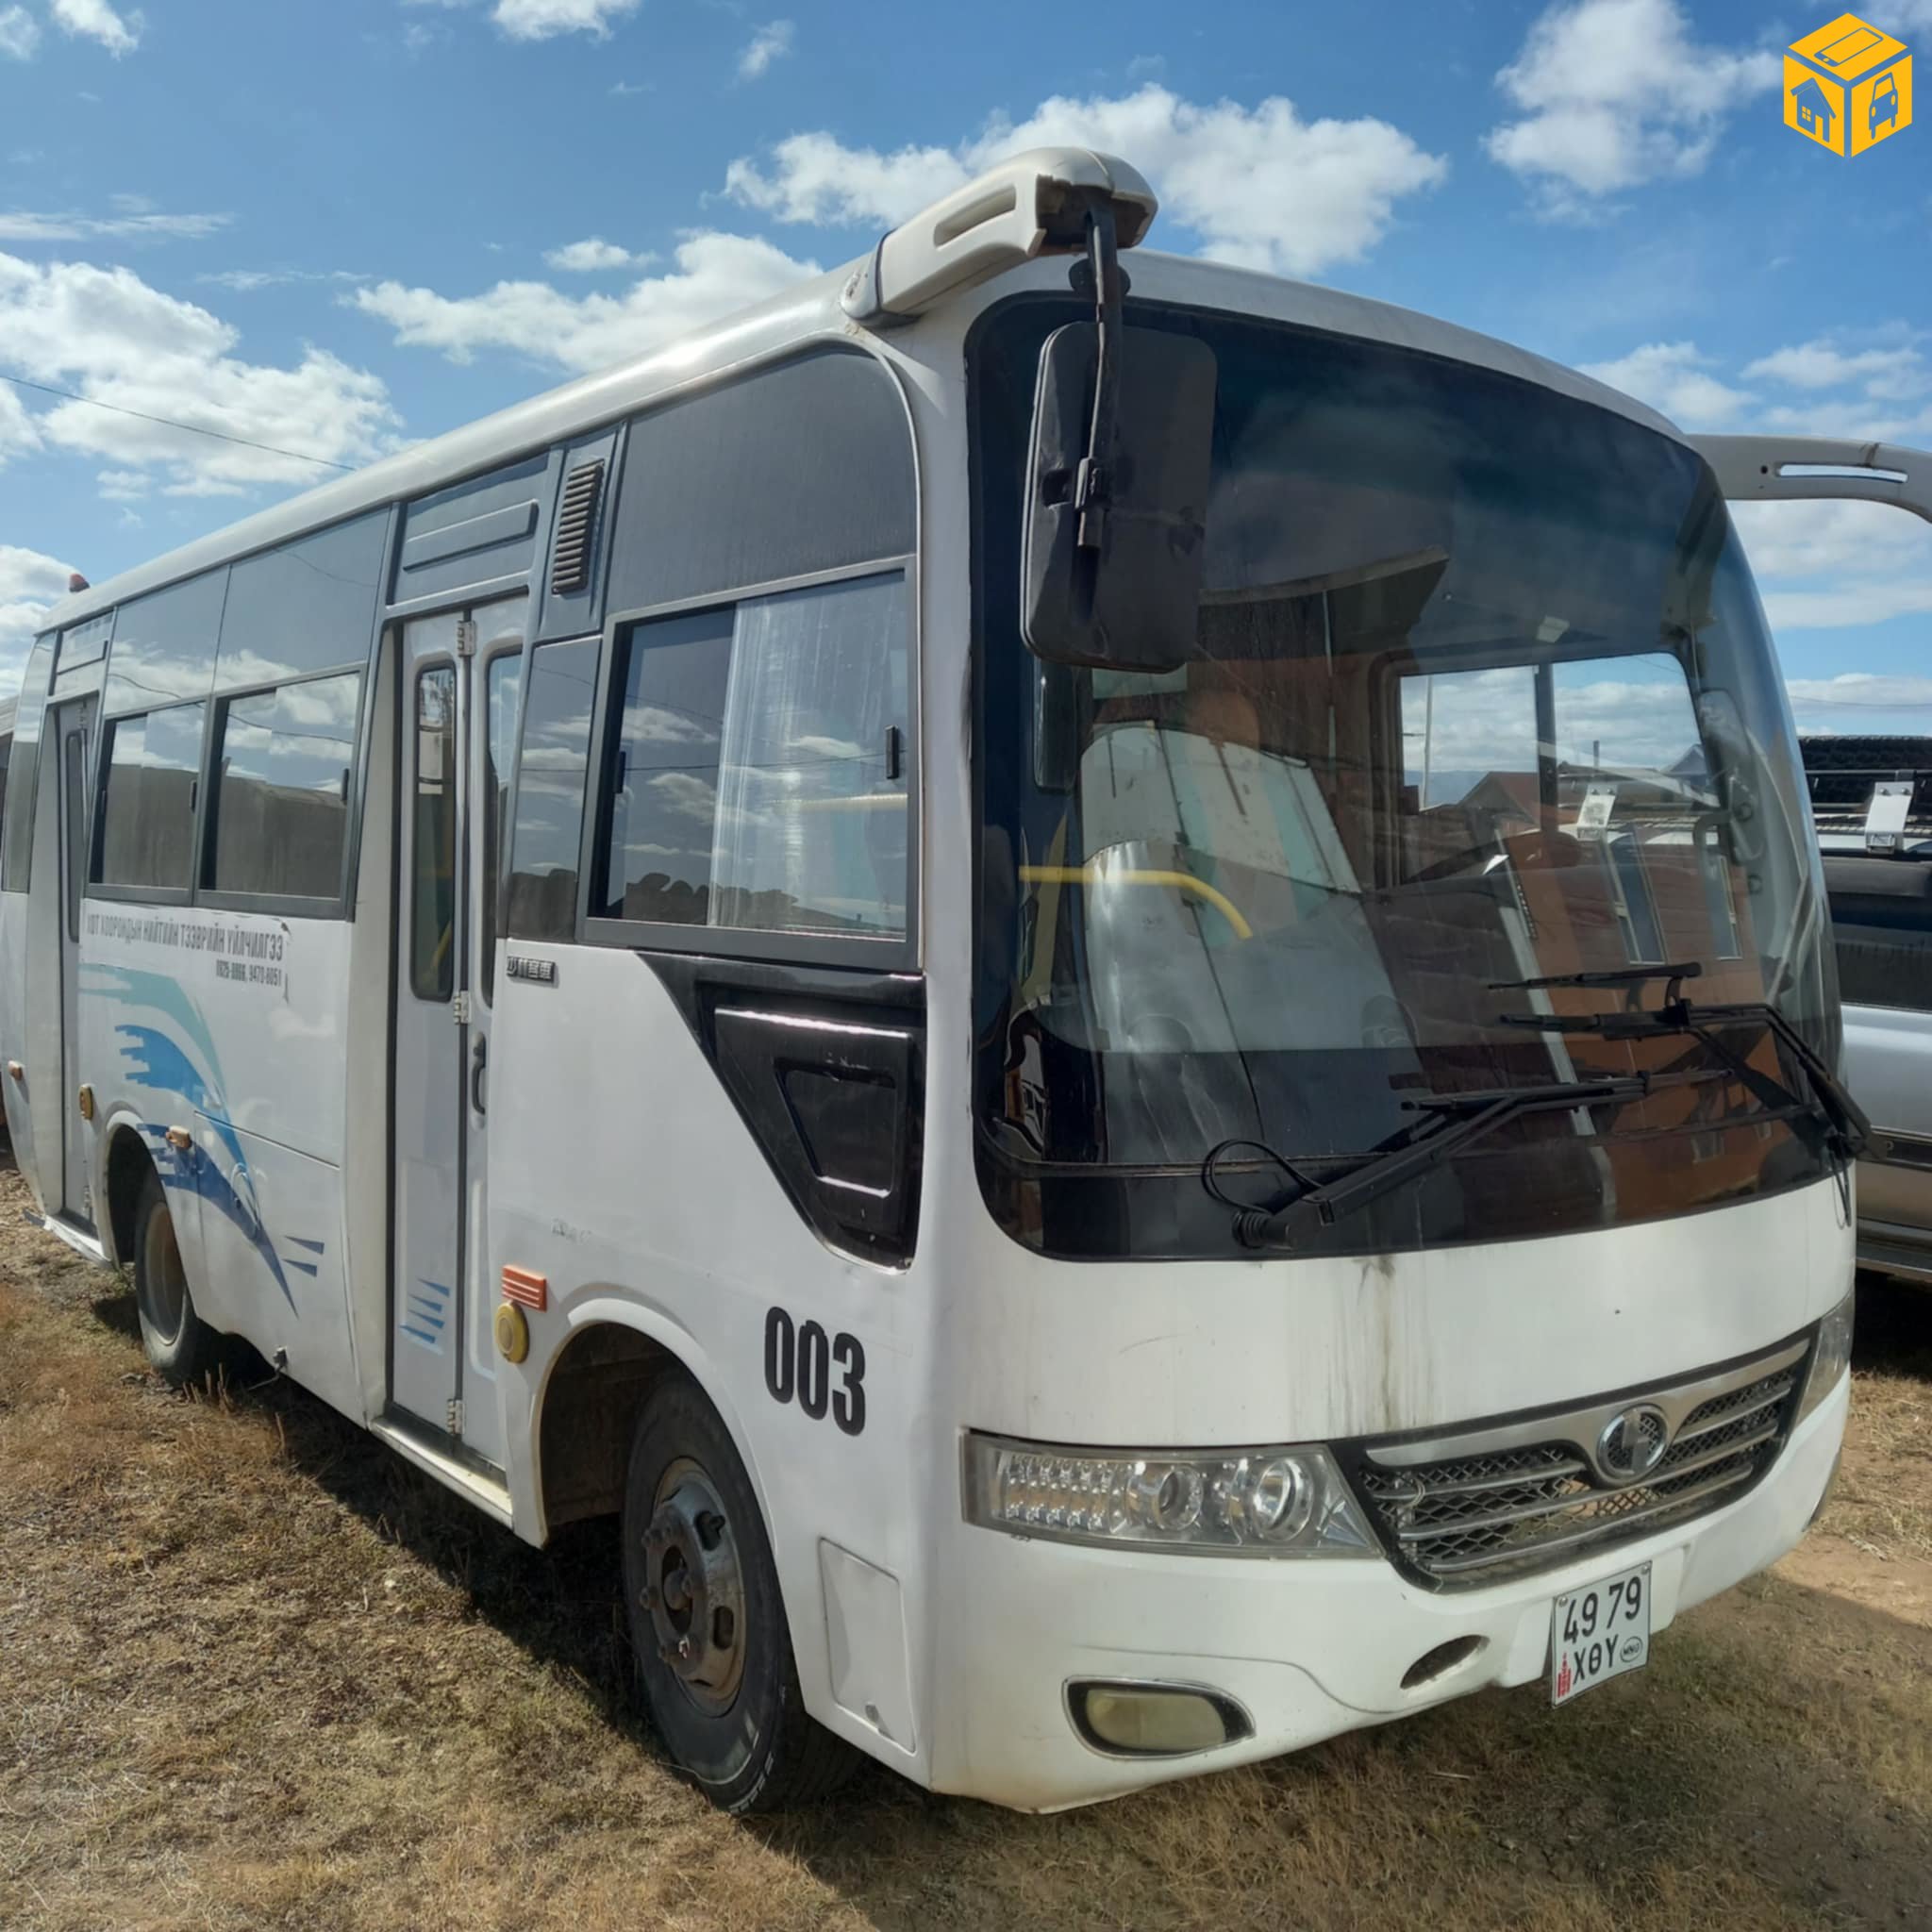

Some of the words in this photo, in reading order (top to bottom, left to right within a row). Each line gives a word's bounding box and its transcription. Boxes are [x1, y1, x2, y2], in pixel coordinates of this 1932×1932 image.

[180, 922, 225, 953] ТЭЭВРИЙН
[227, 924, 283, 960] ҮЙЛЧИЛГЭЭ
[765, 1306, 865, 1437] 003
[1563, 1591, 1598, 1644] 49
[1607, 1576, 1641, 1629] 79
